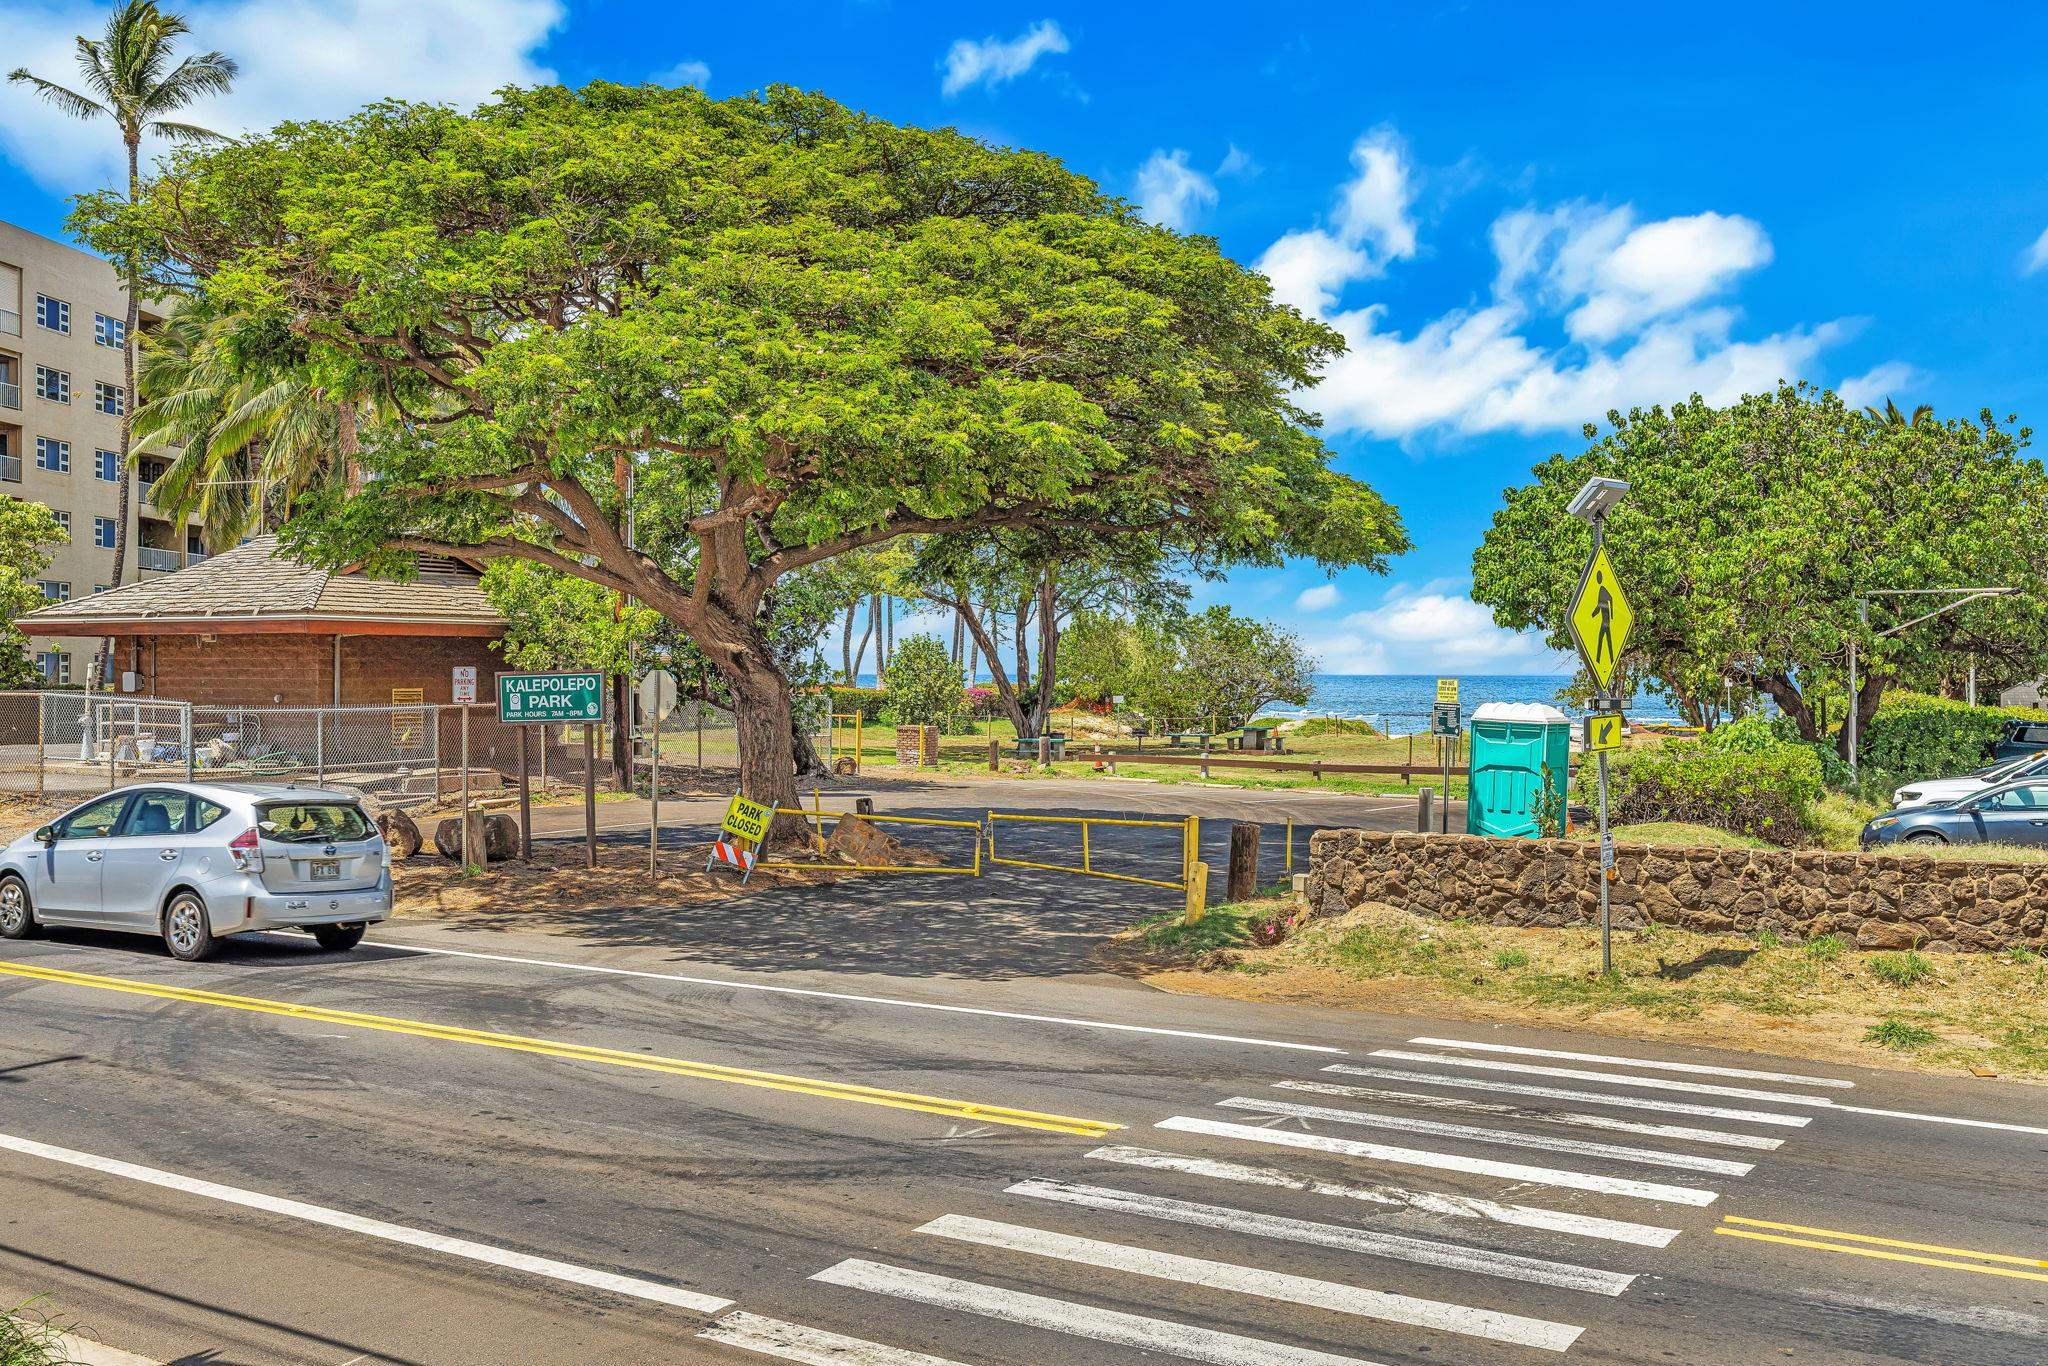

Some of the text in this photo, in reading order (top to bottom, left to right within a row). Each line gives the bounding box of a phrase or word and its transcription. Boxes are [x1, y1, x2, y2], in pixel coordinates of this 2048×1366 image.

[454, 678, 475, 686] PARKING
[505, 677, 596, 693] KALEPOLEPO
[528, 694, 573, 708] PARK
[524, 710, 547, 718] HOURS
[736, 802, 763, 821] PARK
[727, 814, 762, 836] CLOSED
